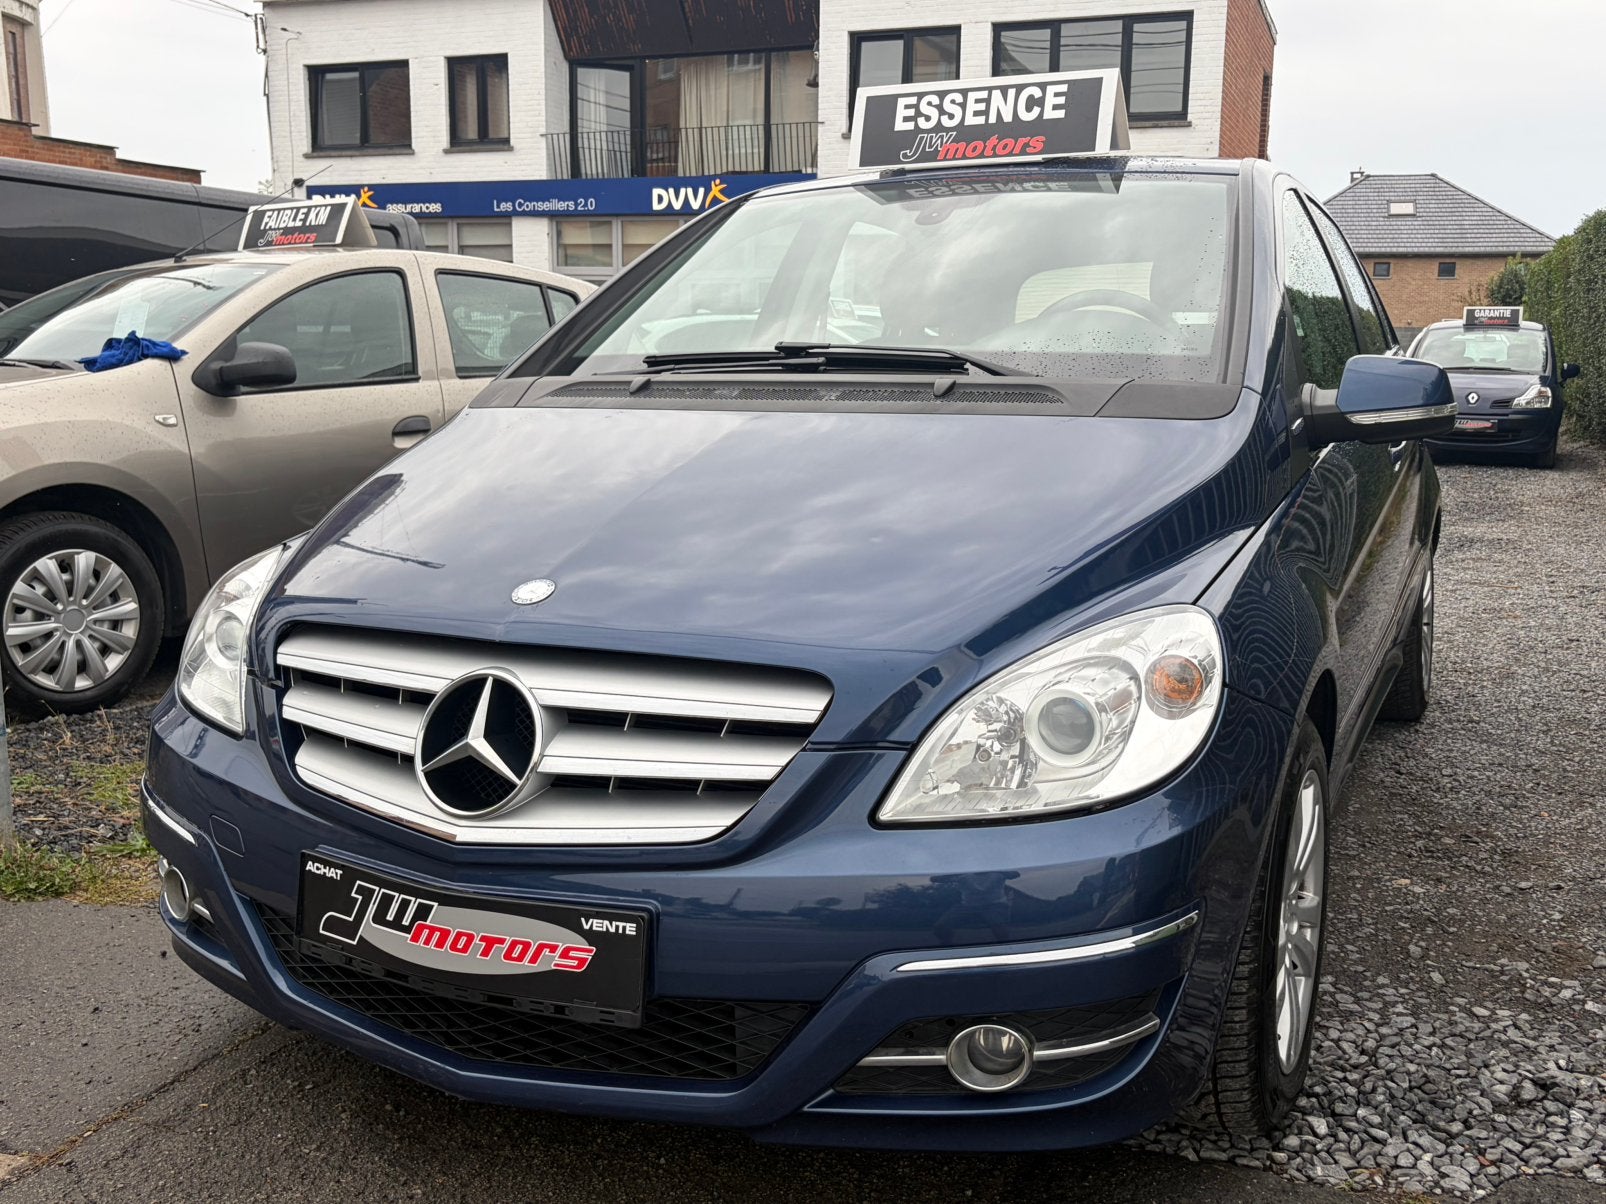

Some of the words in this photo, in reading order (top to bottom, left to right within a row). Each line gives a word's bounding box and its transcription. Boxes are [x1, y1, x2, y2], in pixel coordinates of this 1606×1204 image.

[894, 83, 1068, 131] ESSENCE
[899, 131, 956, 161] JW
[937, 134, 1046, 160] motors
[386, 202, 442, 213] assurances
[494, 200, 512, 211] Les
[515, 199, 575, 211] Conseillers
[577, 199, 595, 211] 2.0
[652, 187, 705, 210] DVV
[260, 207, 307, 230] FAIBLE
[306, 206, 331, 226] KM
[273, 232, 317, 245] motors
[1474, 309, 1511, 317] GARANTIE
[305, 861, 343, 881] ACHAT
[319, 880, 438, 945] JW
[580, 917, 637, 936] VENTE
